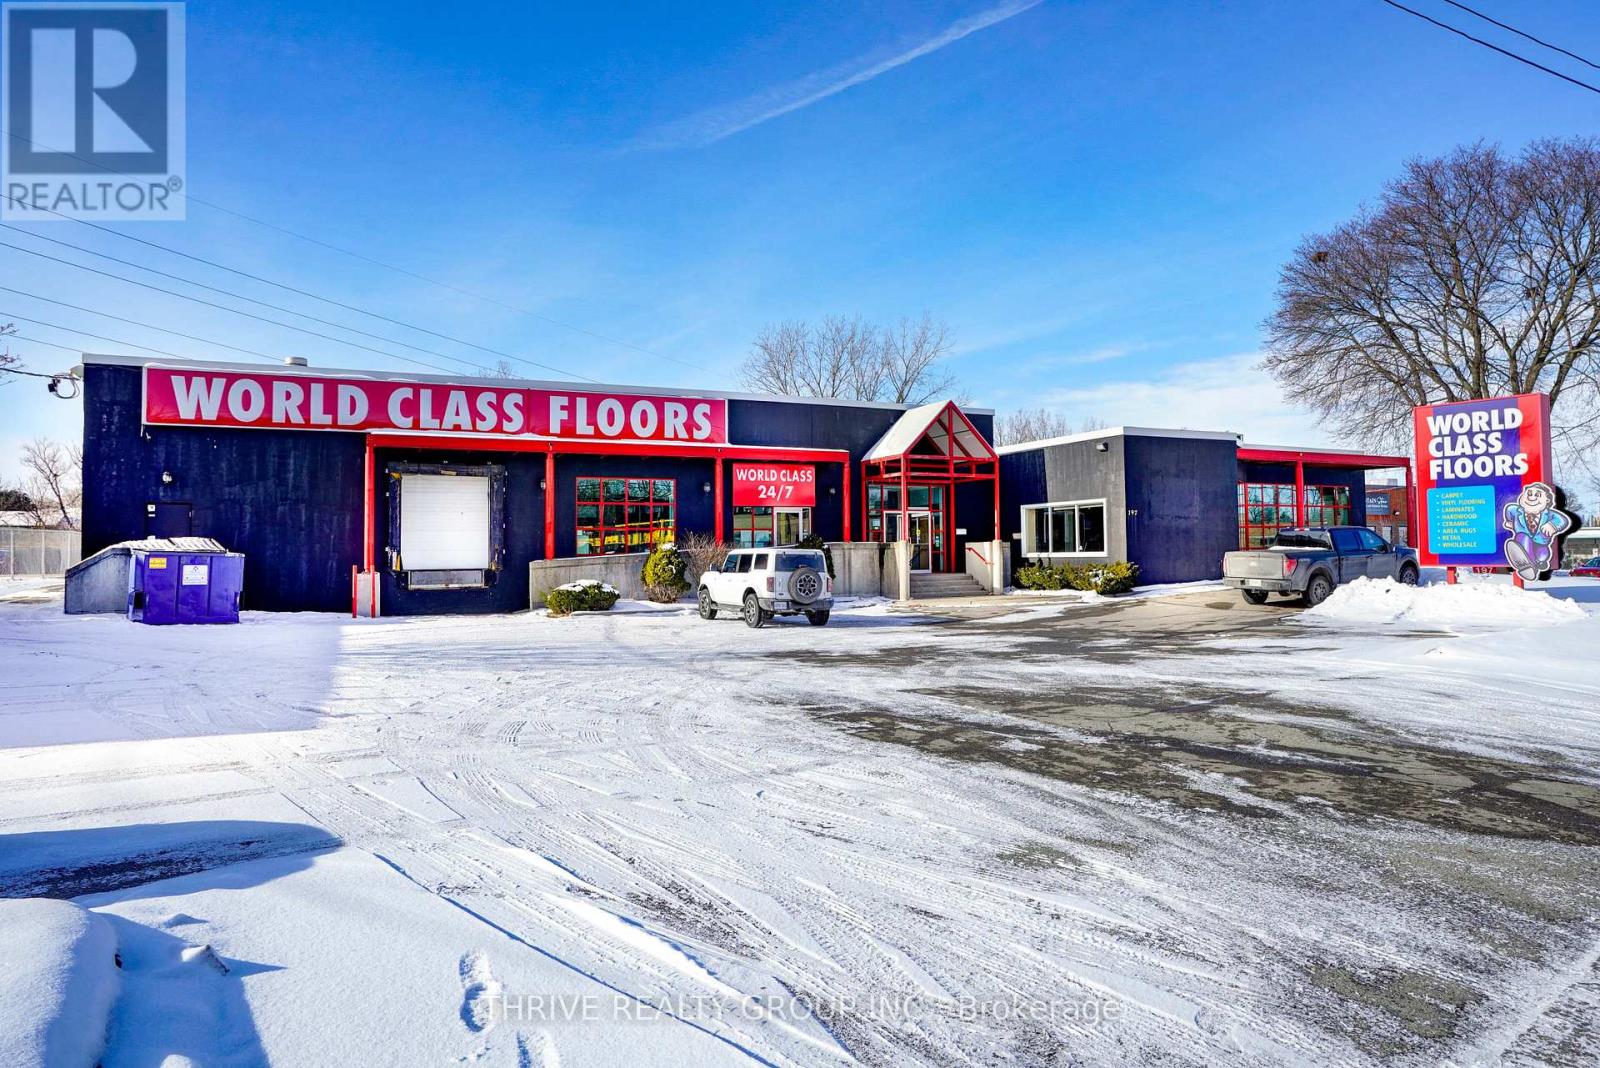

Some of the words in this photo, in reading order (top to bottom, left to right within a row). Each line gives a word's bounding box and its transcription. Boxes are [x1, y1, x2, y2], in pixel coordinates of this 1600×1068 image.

[170, 375, 369, 426] WORLD
[387, 387, 524, 432] CLASS
[549, 395, 712, 440] FLOORS
[1426, 407, 1524, 437] WORLD
[1428, 432, 1503, 458] CLASS
[736, 468, 777, 482] WORLD
[780, 469, 813, 483] CLASS
[1429, 453, 1529, 480] FLOORS
[757, 485, 794, 501] 24/7
[1442, 541, 1478, 549] WHOLESALE
[1475, 566, 1493, 574] 197
